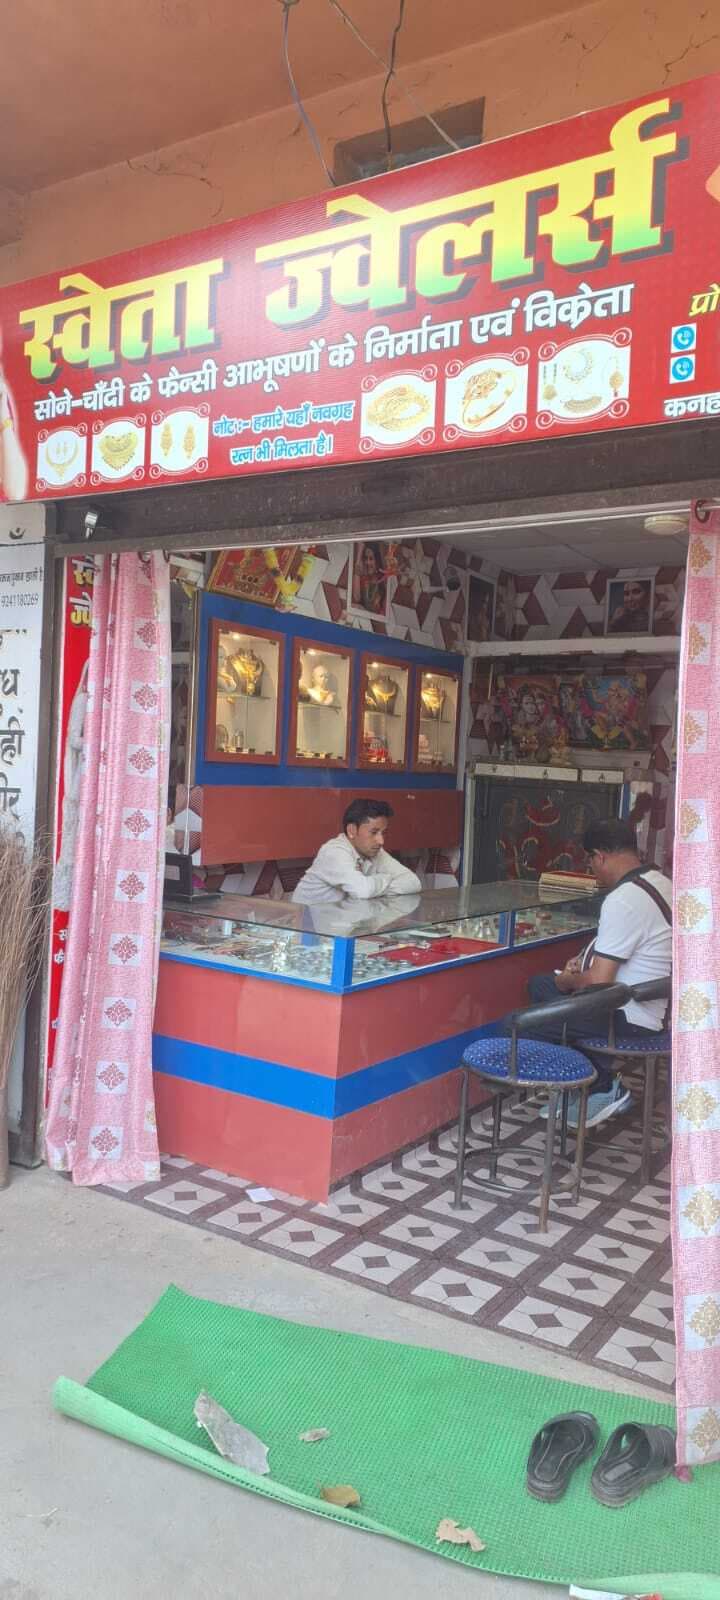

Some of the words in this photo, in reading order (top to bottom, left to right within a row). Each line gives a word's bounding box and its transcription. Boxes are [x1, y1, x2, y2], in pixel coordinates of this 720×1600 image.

[19, 258, 224, 379] स्वेता
[255, 98, 677, 326] ज्वेलर्स
[34, 377, 126, 421] सोने-चाँदी
[130, 374, 153, 403] के
[158, 358, 218, 398] फैन्सी
[223, 338, 326, 392] आभूषणों
[328, 332, 357, 368] के
[364, 315, 463, 364] निर्माता
[469, 297, 522, 343] एवं
[524, 283, 635, 331] विक्रेता
[230, 445, 254, 465] रत्न
[254, 438, 271, 460] भी
[272, 436, 313, 459] मिलता
[314, 430, 334, 455] है।
[251, 406, 284, 433] हमारे
[284, 401, 311, 426] यहाँ
[311, 401, 355, 425] नवग्रह
